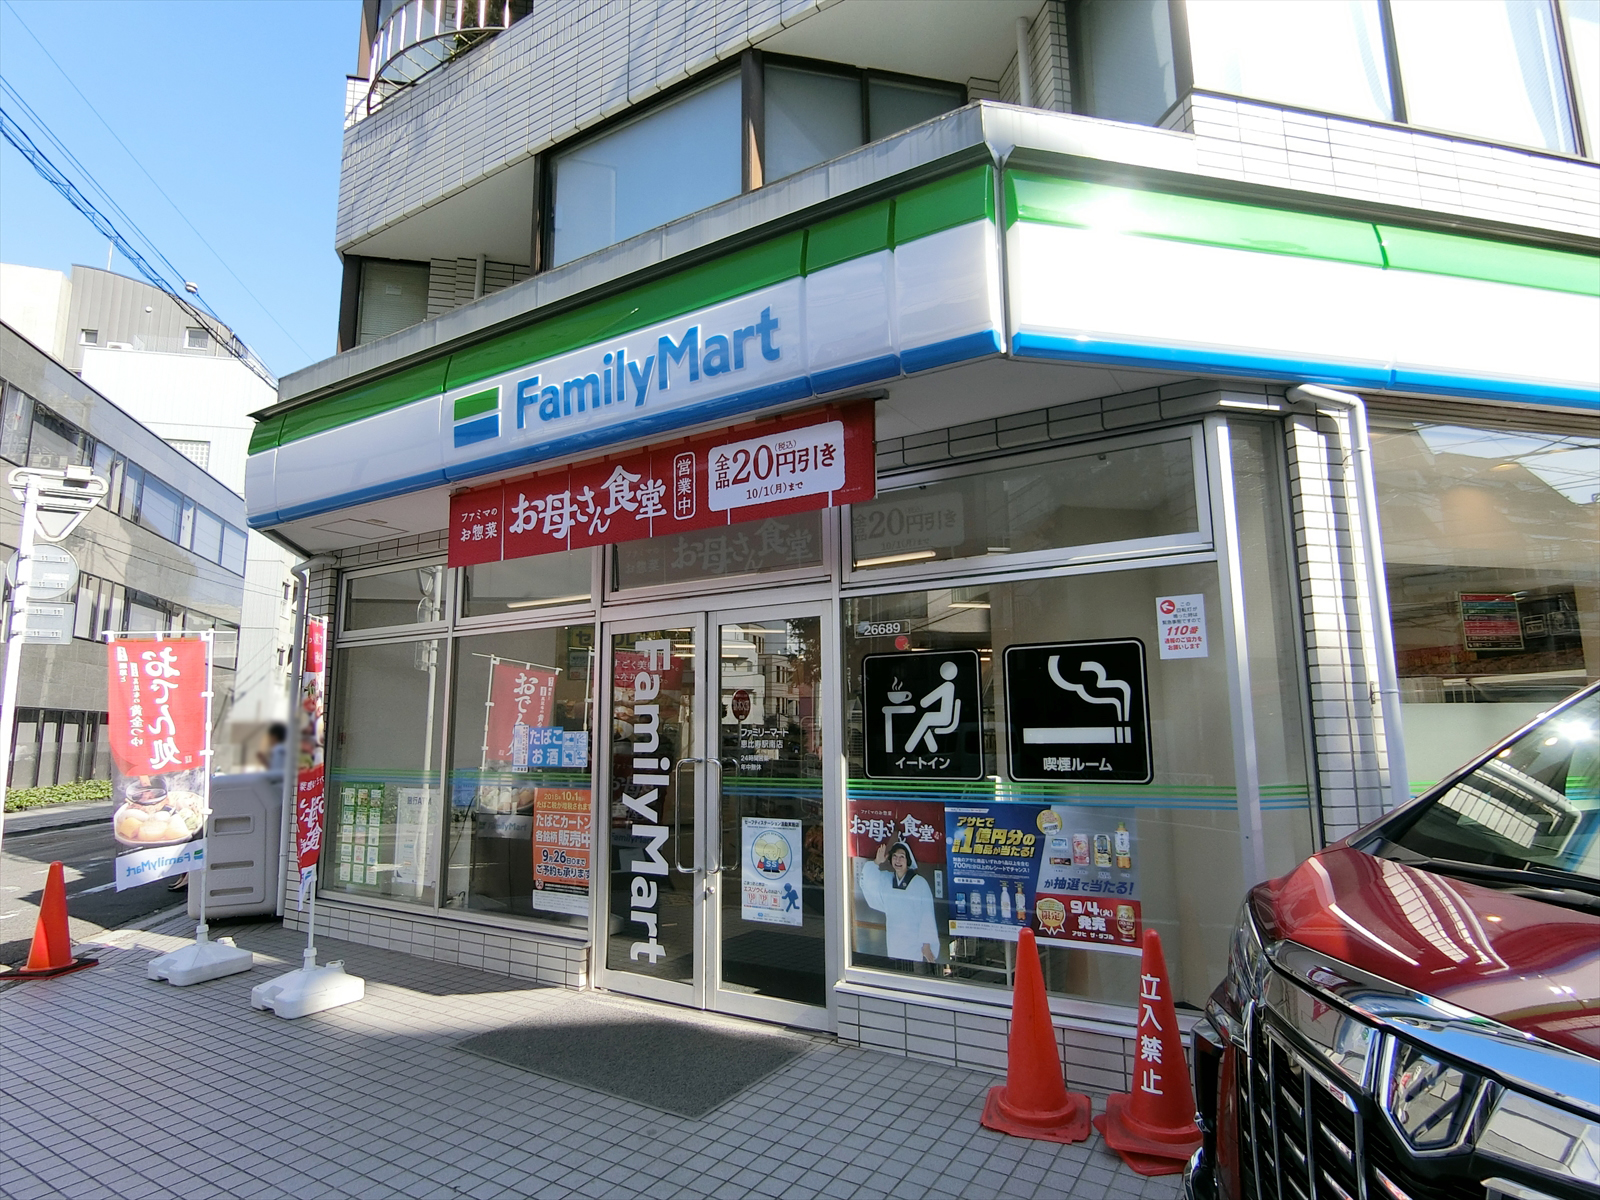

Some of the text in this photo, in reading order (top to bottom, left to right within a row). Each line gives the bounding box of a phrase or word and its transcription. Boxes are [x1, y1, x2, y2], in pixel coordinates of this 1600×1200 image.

[515, 306, 782, 430] FamilyMart
[715, 453, 730, 491] 全品
[732, 443, 837, 485] 20円引き
[676, 458, 693, 516] 営業中
[746, 481, 804, 500] 10/1(月)まで
[509, 465, 668, 540] お母さん食堂
[461, 507, 498, 523] ファミマの
[460, 521, 498, 543] お惣菜
[863, 623, 901, 636] 26689
[1167, 625, 1199, 637] 110番
[529, 729, 564, 746] たばこ
[741, 728, 790, 738] ファミリーマート
[532, 748, 560, 766] お酒
[895, 757, 951, 770] イートイン
[1043, 757, 1113, 772] 喫煙ルーム
[622, 638, 671, 964] FamilyMart
[536, 813, 592, 830] たばこカートン
[849, 813, 936, 844] お母さん食堂
[956, 816, 995, 828] アサヒで
[972, 844, 1036, 858] 商品が当たる!
[536, 864, 591, 880] ご予約も承ります
[1043, 876, 1135, 896] が抽選で当たる!
[1041, 911, 1062, 922] 限定
[1069, 900, 1114, 917] 9/4(火)
[1077, 915, 1107, 932] 発売
[1071, 930, 1088, 938] アサヒ
[1140, 973, 1164, 1095] 立入禁止
